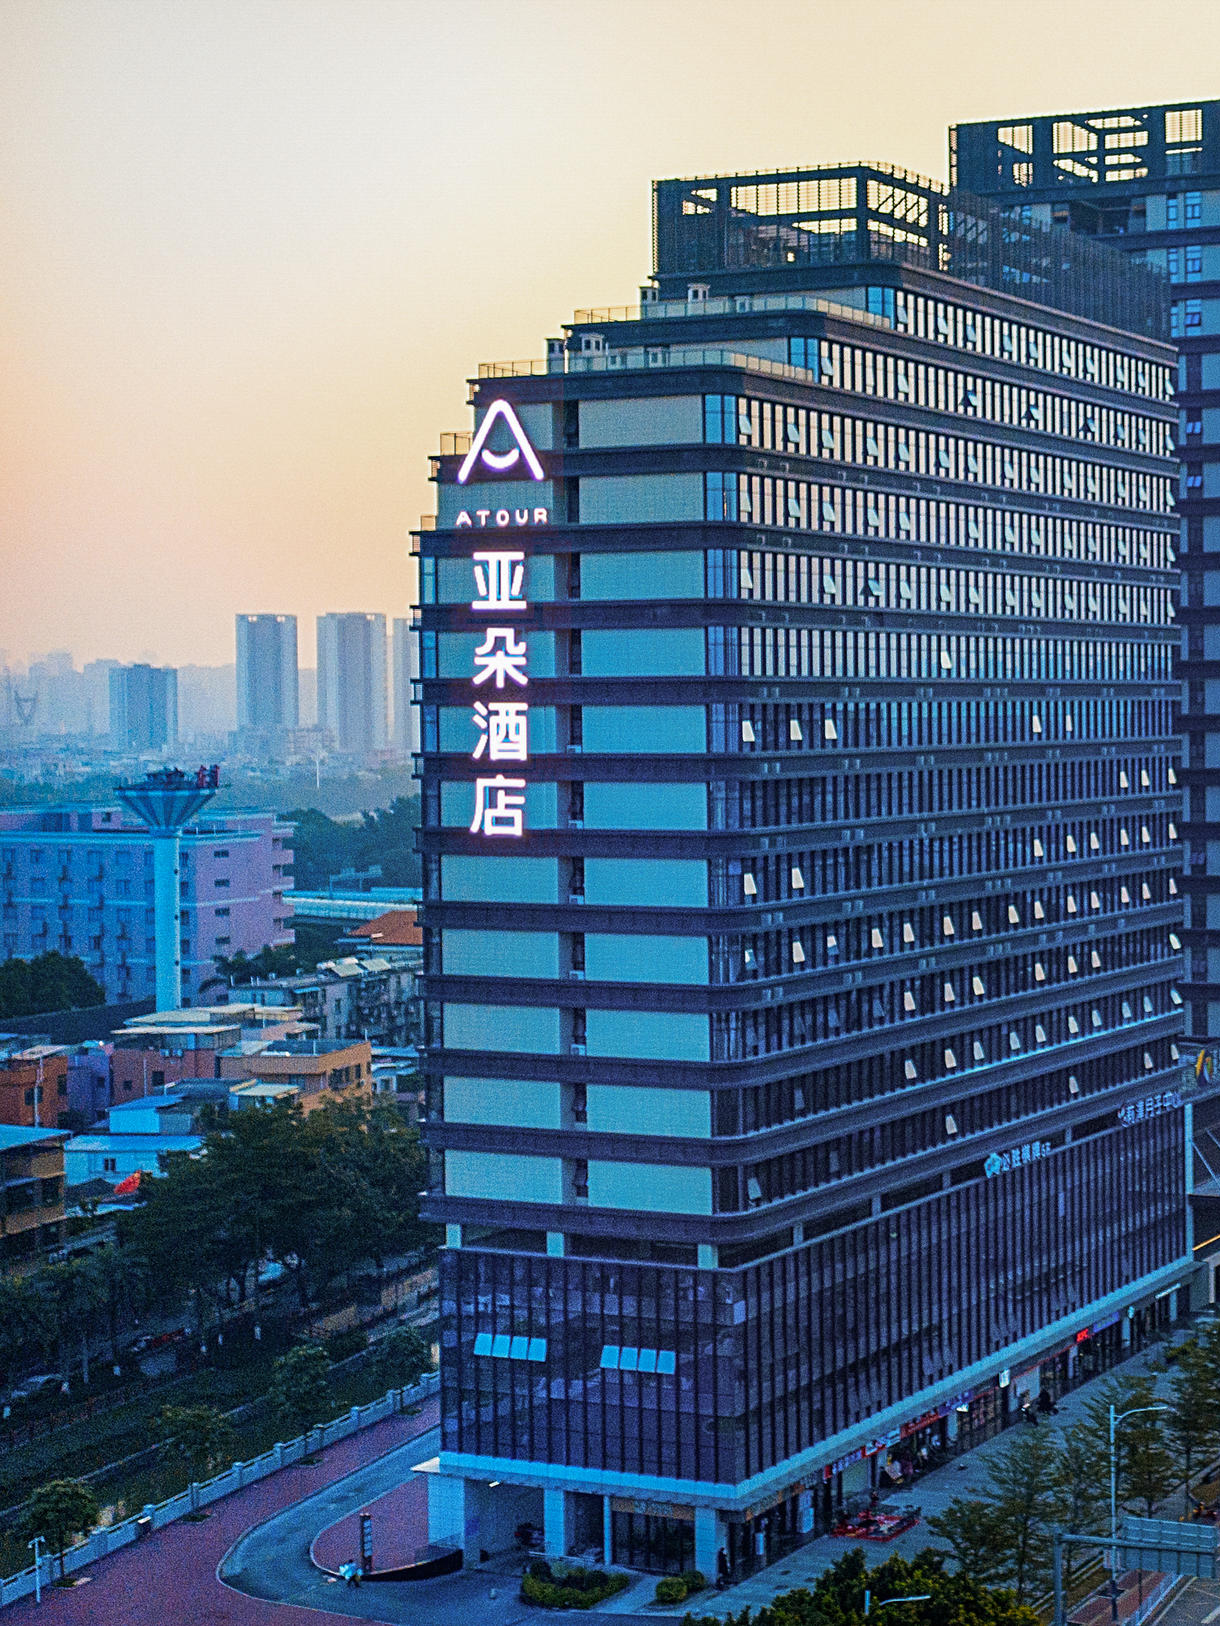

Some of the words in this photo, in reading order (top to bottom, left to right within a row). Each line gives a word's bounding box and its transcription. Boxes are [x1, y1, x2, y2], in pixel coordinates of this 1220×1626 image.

[455, 508, 549, 527] ATOUR
[469, 551, 529, 837] 亚朵酒店
